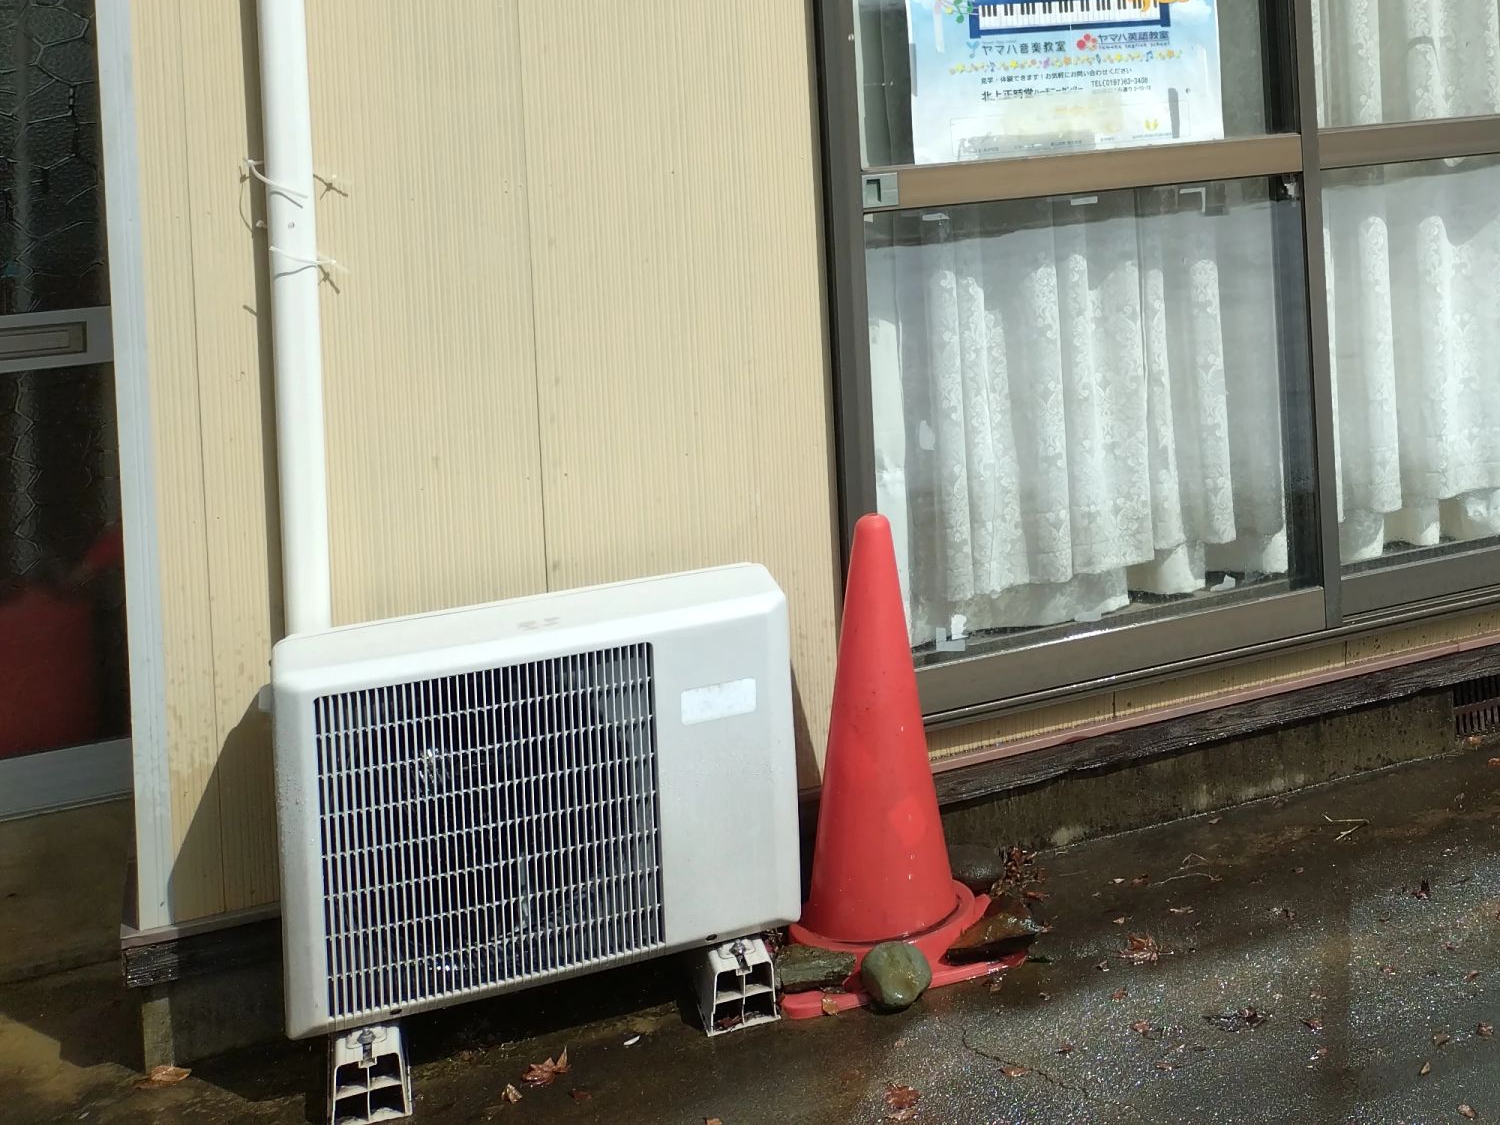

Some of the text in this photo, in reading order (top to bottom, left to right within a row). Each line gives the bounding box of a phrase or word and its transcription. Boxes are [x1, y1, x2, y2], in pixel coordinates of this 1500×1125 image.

[981, 41, 1066, 56] ヤマハ音楽教室
